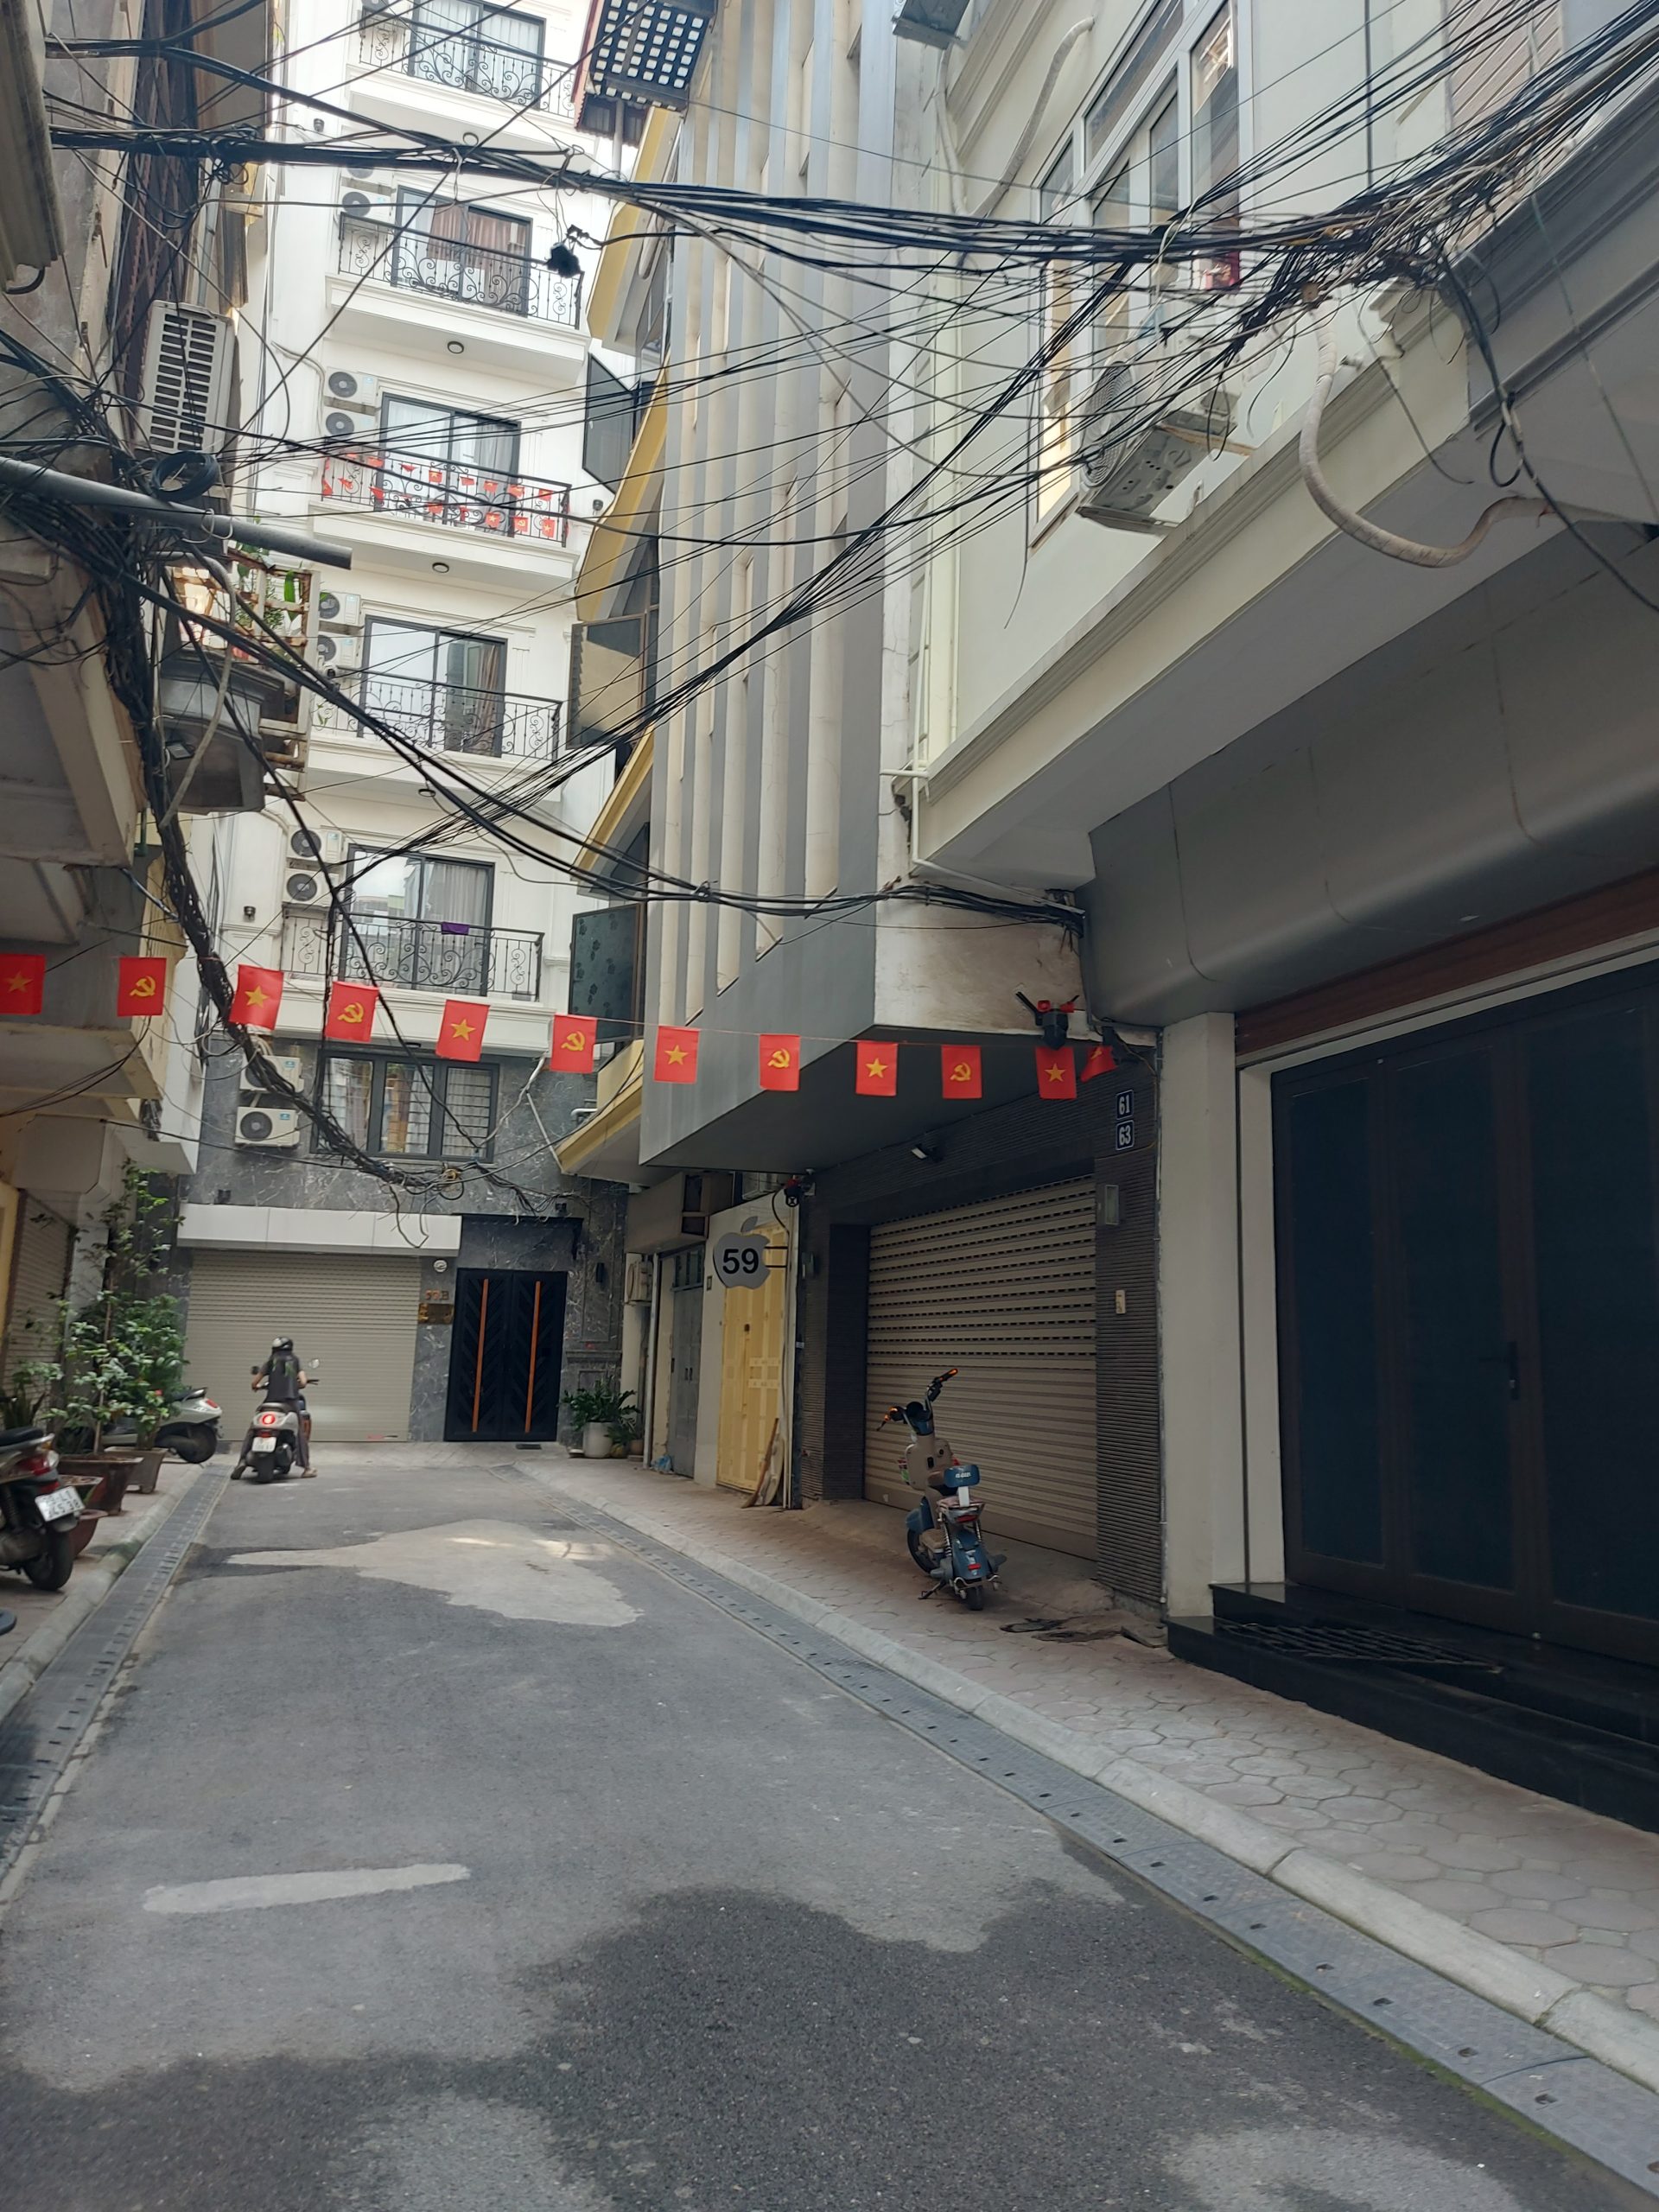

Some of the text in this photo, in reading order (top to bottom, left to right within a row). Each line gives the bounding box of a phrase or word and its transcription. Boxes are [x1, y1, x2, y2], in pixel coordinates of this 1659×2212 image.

[1118, 1094, 1130, 1115] 61
[1118, 1124, 1131, 1146] 63
[722, 1248, 760, 1274] 59
